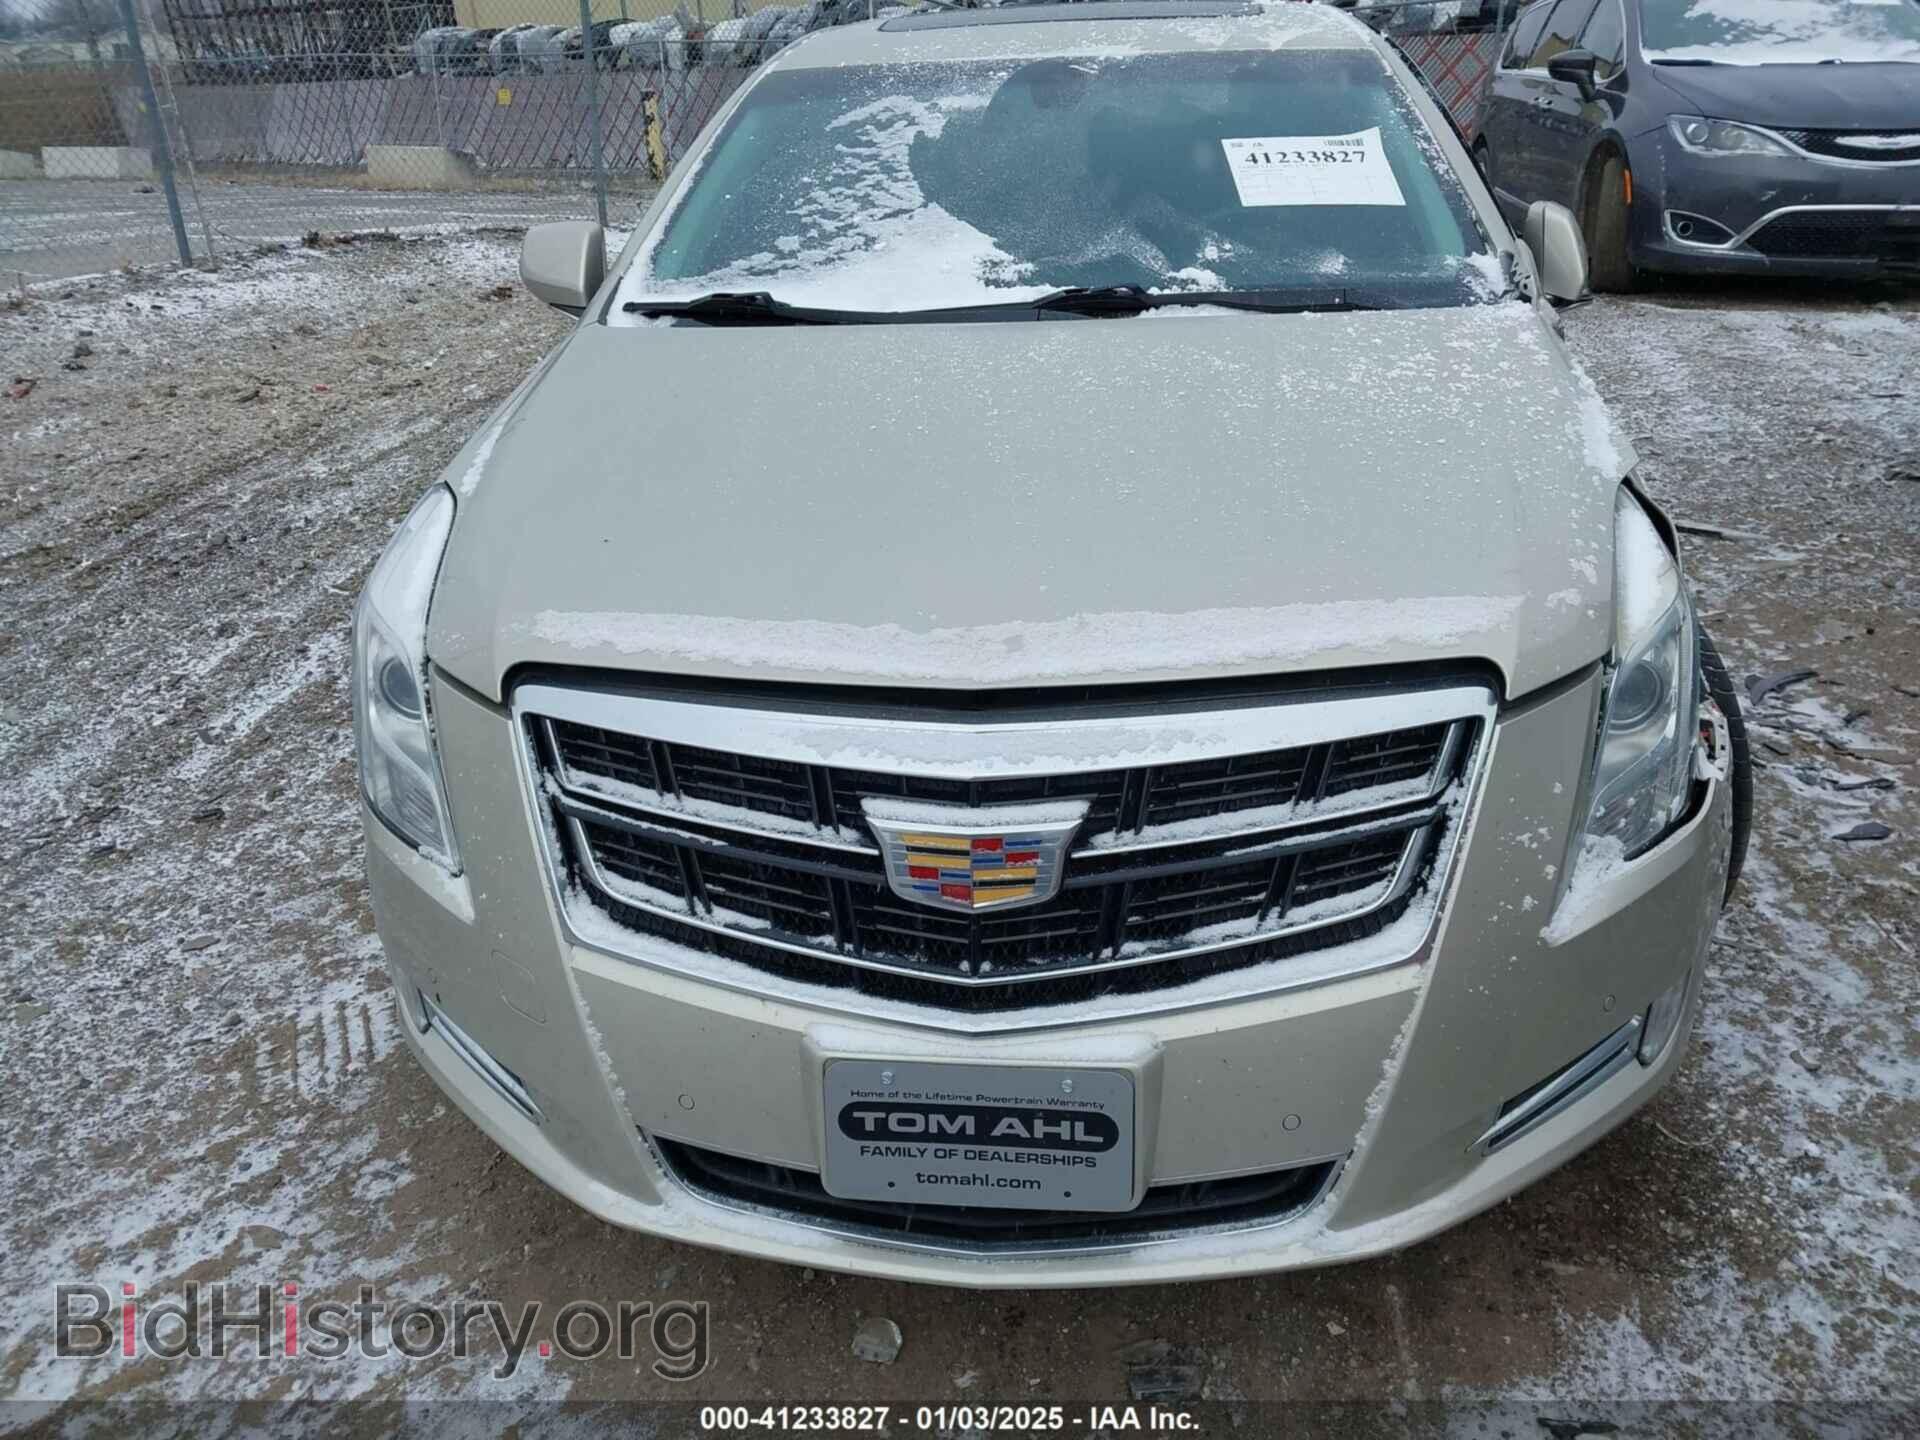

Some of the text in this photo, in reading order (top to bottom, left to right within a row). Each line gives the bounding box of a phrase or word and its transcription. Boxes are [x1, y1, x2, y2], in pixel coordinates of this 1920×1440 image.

[1245, 151, 1365, 164] 41233827
[851, 1089, 1105, 1110] Home of the Lifetime Powertrain Warranty
[852, 1111, 1104, 1142] TOM AHL
[860, 1145, 1097, 1168] FAMILY OF DEALERSHIPS
[916, 1172, 1041, 1190] tomahl.com
